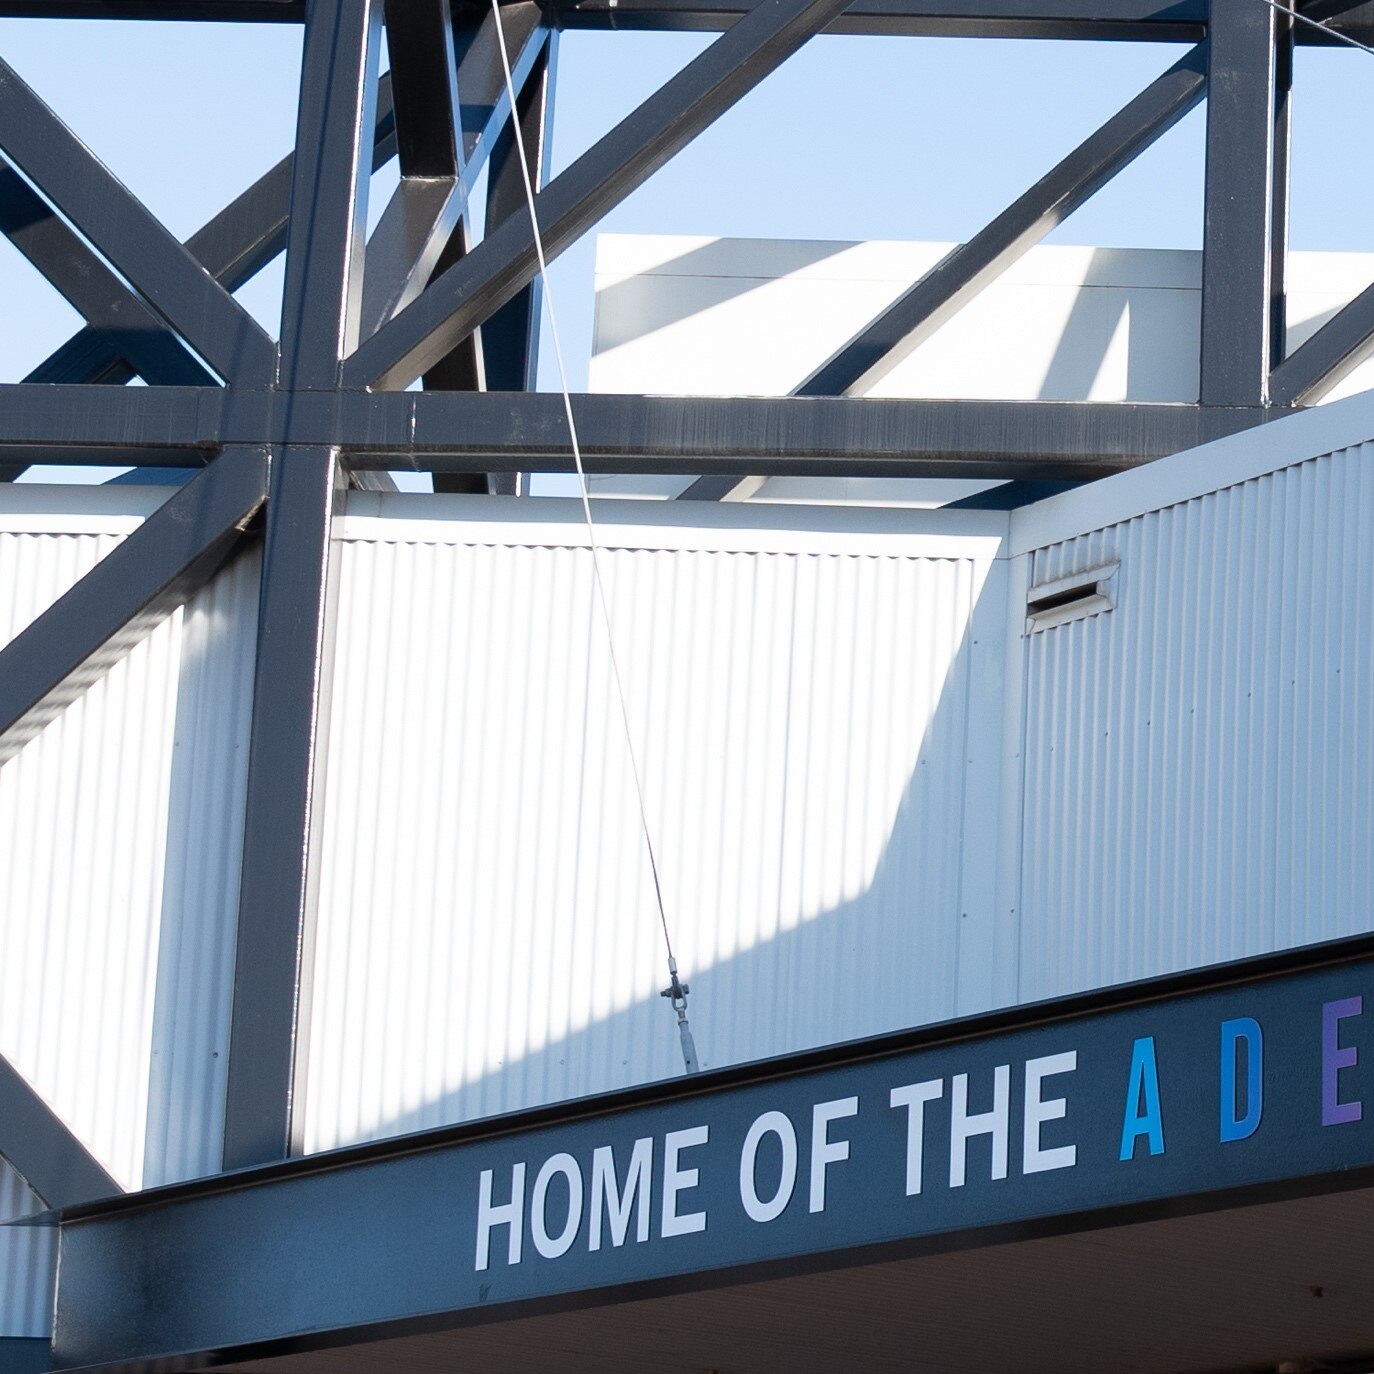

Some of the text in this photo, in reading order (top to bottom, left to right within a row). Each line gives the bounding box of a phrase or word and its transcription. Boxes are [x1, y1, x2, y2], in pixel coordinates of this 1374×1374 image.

[475, 1125, 709, 1270] HOME
[740, 1097, 858, 1223] OF
[890, 1050, 1077, 1196] THE
